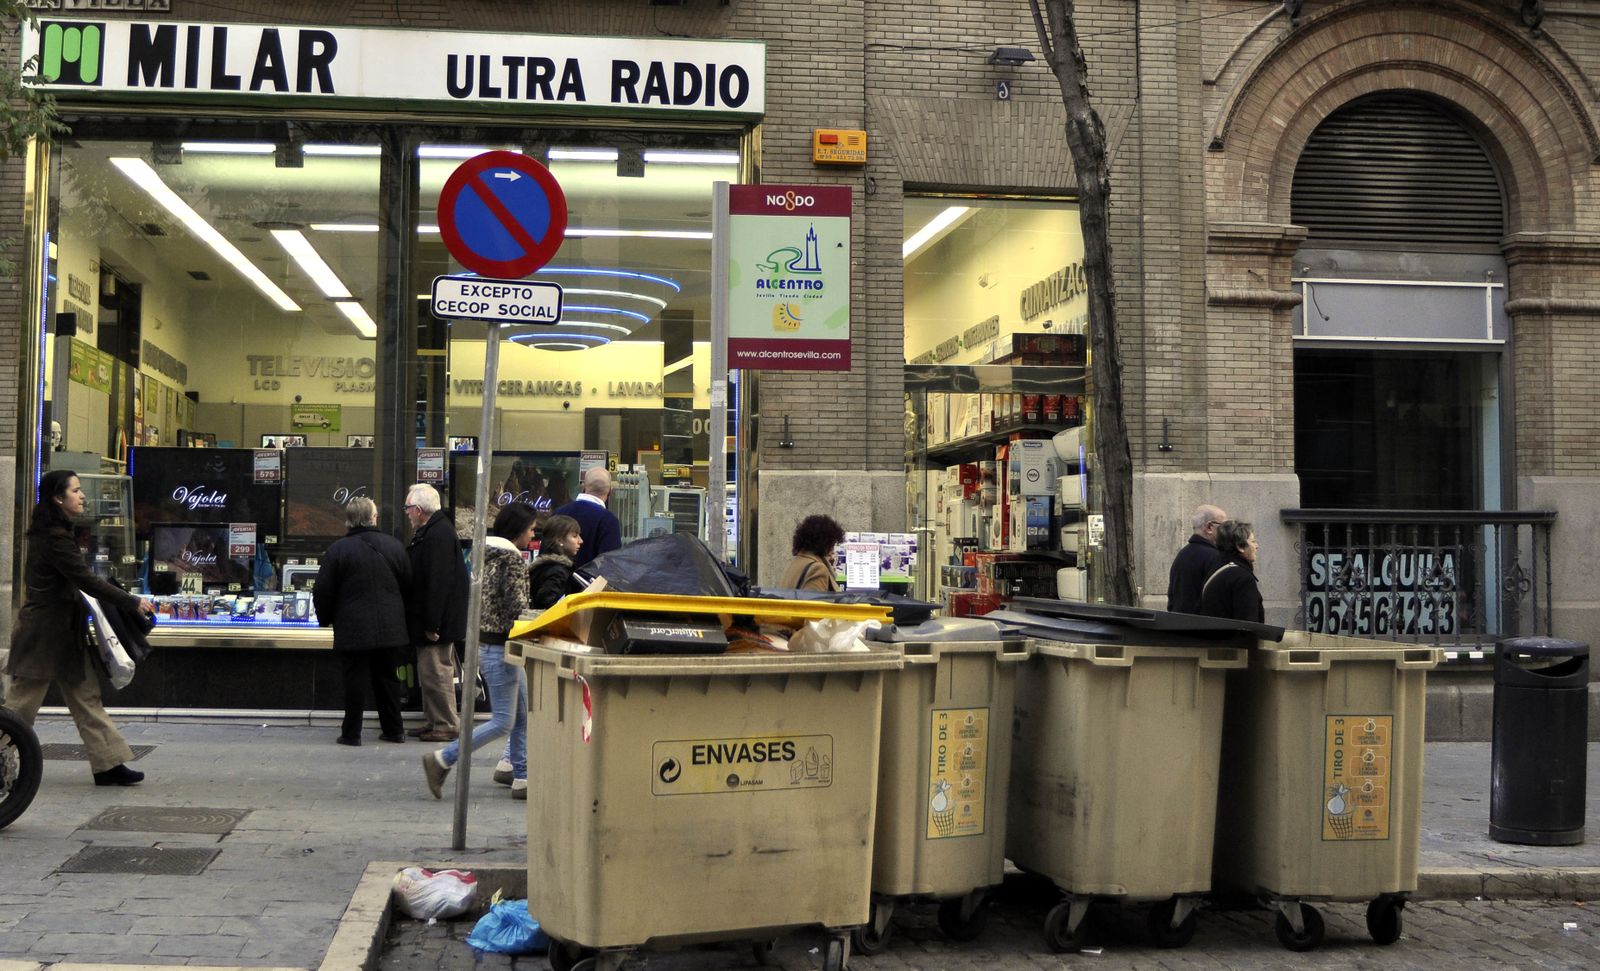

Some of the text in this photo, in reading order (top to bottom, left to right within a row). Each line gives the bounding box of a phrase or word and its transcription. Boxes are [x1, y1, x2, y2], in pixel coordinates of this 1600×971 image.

[127, 23, 750, 108] MILAR ULTRA RADIO
[460, 284, 533, 300] EXCEPTO
[756, 278, 824, 290] ALCENTRO
[437, 300, 555, 318] CECOP SOCIAL
[736, 350, 842, 360] www.alcentrosevilla.com
[254, 379, 281, 391] LCD
[453, 379, 583, 397] VITRCERAMICAS
[172, 485, 228, 510] Vajolet
[181, 550, 217, 566] Vajolet
[1310, 553, 1343, 586] SE
[938, 724, 948, 741] DE
[1334, 729, 1344, 746] DE
[692, 741, 796, 765] ENVASES
[937, 744, 947, 776] TIRO
[1333, 749, 1344, 779] TIRO
